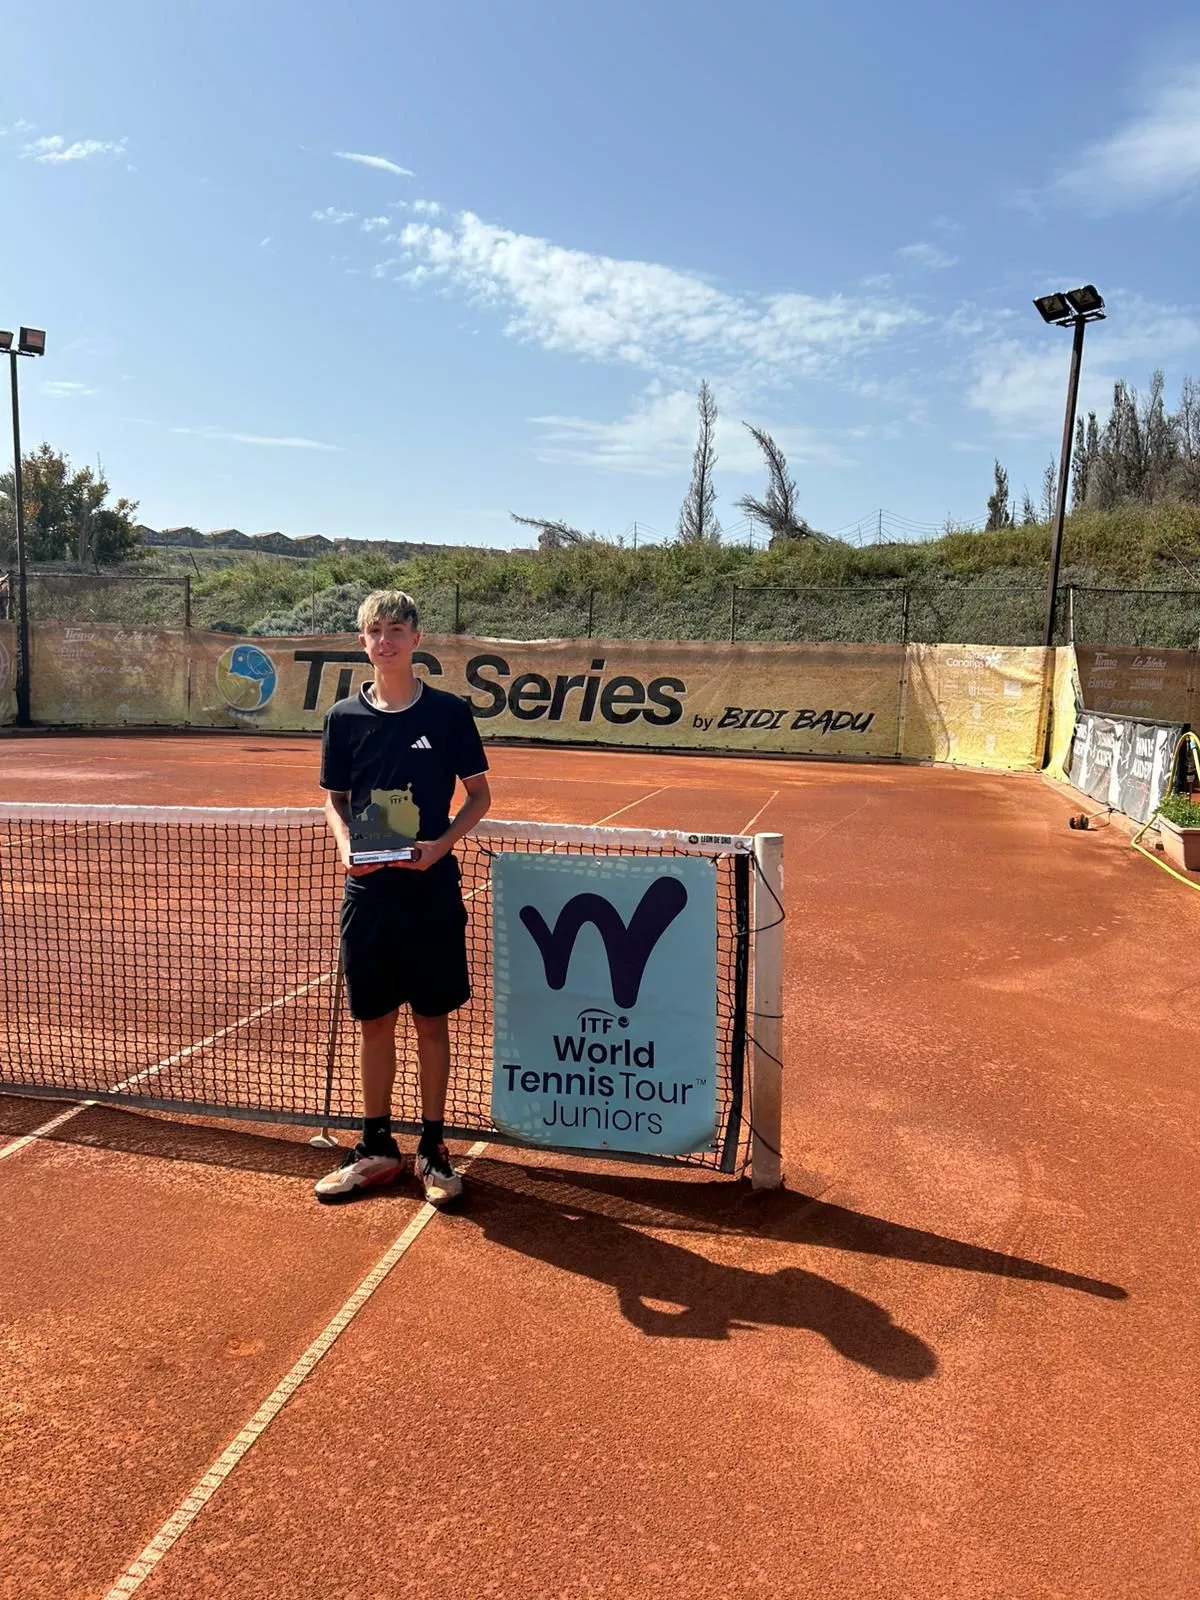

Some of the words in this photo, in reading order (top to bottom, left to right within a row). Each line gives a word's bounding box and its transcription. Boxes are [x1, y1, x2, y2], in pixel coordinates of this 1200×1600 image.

[1094, 652, 1118, 667] Tirma
[465, 654, 687, 726] Series
[692, 714, 714, 731] by
[718, 706, 789, 730] BIDI
[791, 709, 875, 735] BADU
[581, 1016, 614, 1034] ITF
[553, 1035, 655, 1069] World
[503, 1064, 615, 1097] Tennis
[543, 1100, 663, 1135] Juniors
